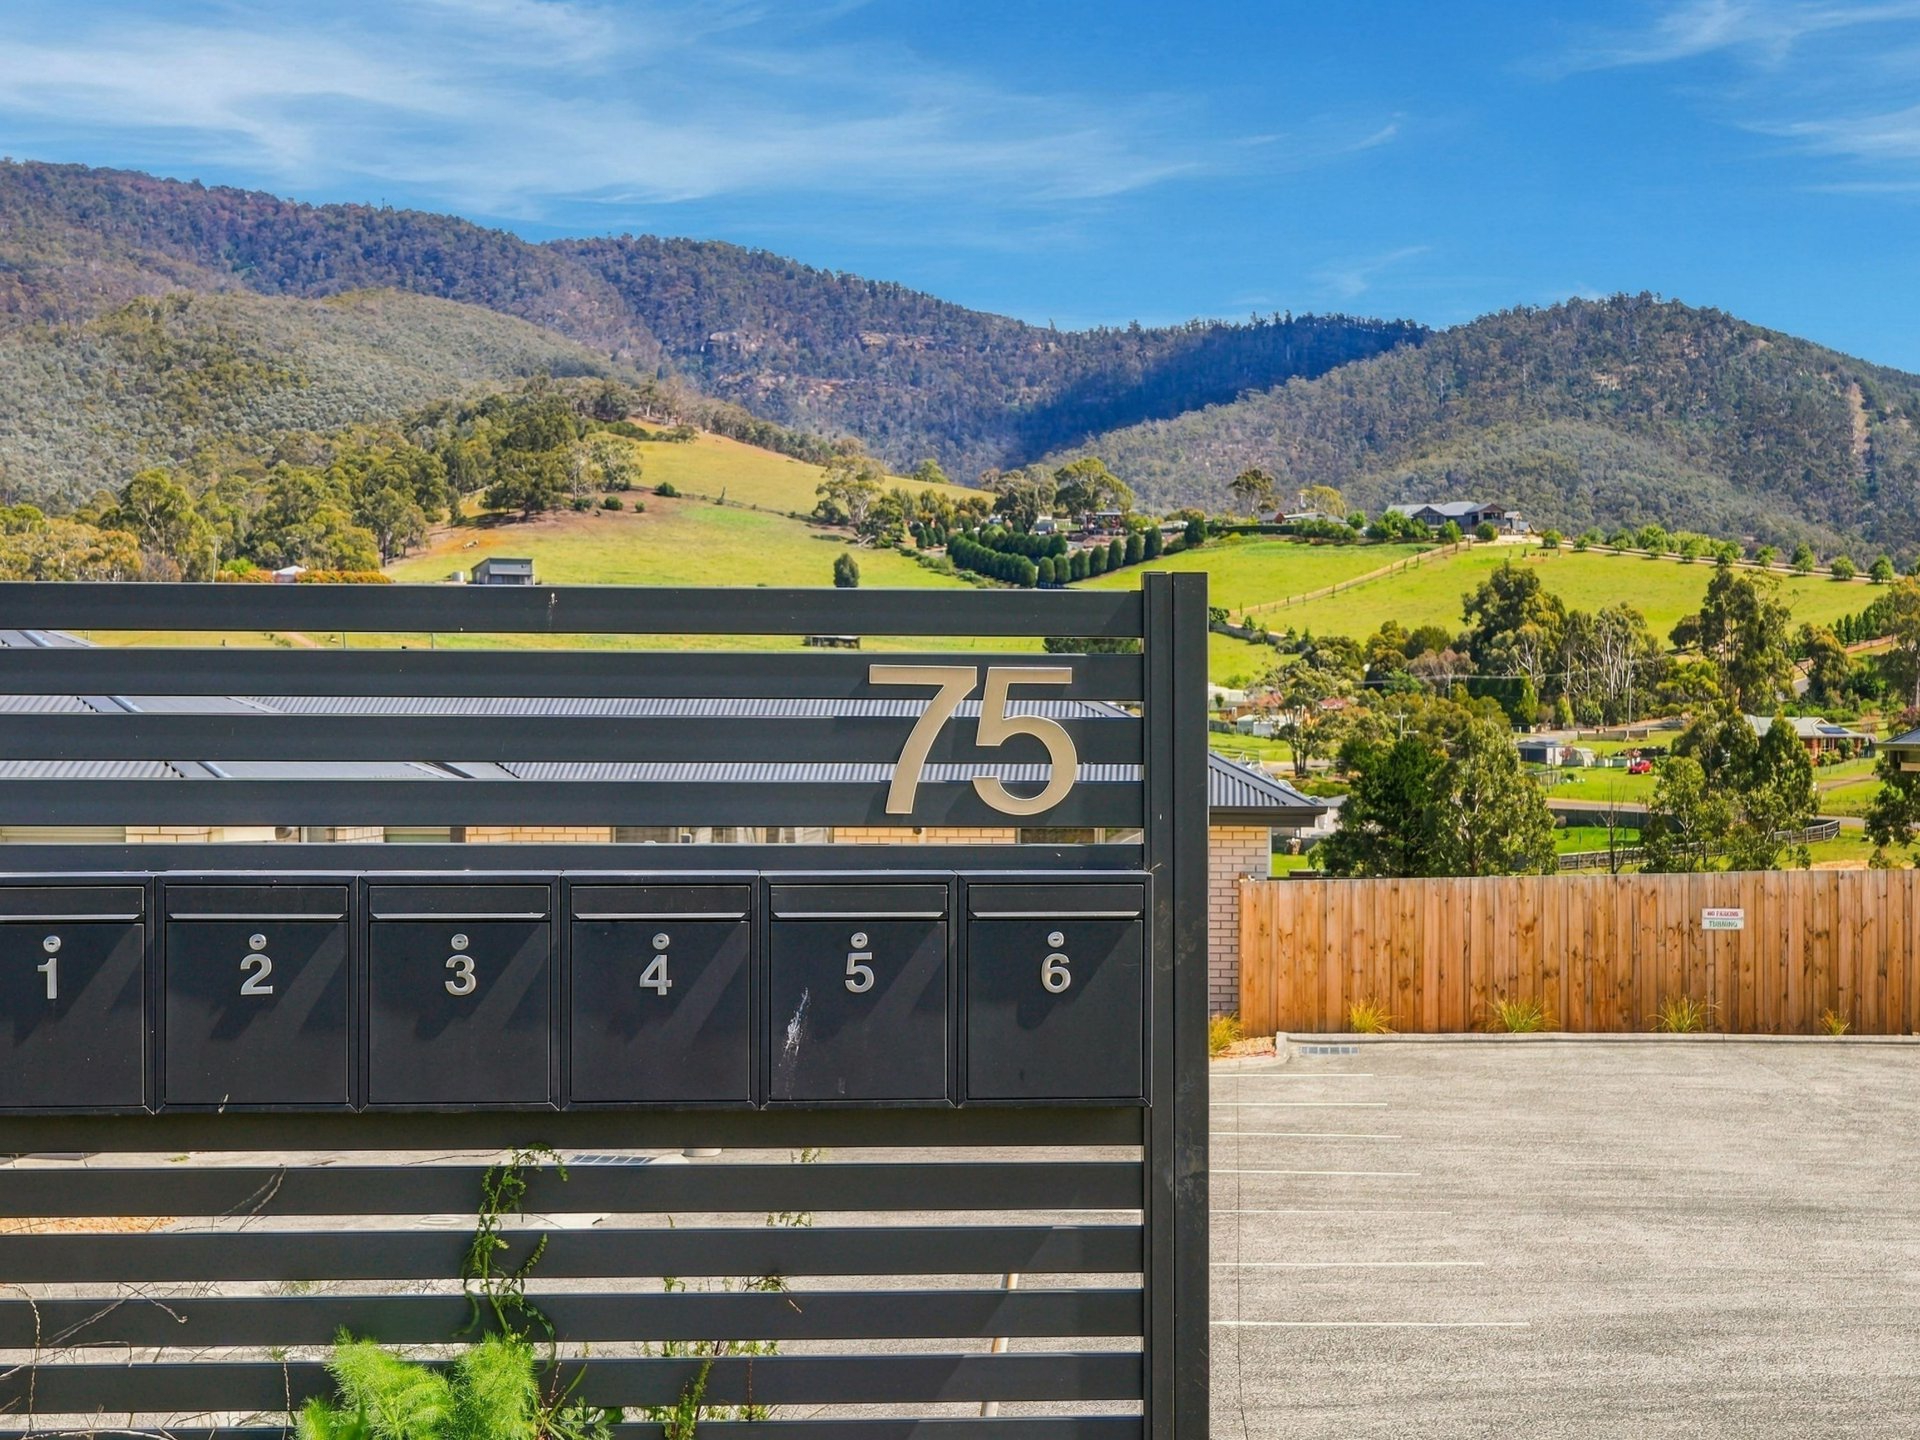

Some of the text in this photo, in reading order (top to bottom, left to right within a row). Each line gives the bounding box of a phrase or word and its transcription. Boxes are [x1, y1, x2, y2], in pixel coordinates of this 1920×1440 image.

[868, 664, 1078, 816] 75
[36, 957, 58, 1000] 1
[240, 953, 274, 996] 2
[444, 954, 477, 996] 3
[639, 954, 673, 996] 4
[844, 951, 875, 993] 5
[1041, 952, 1072, 994] 6
